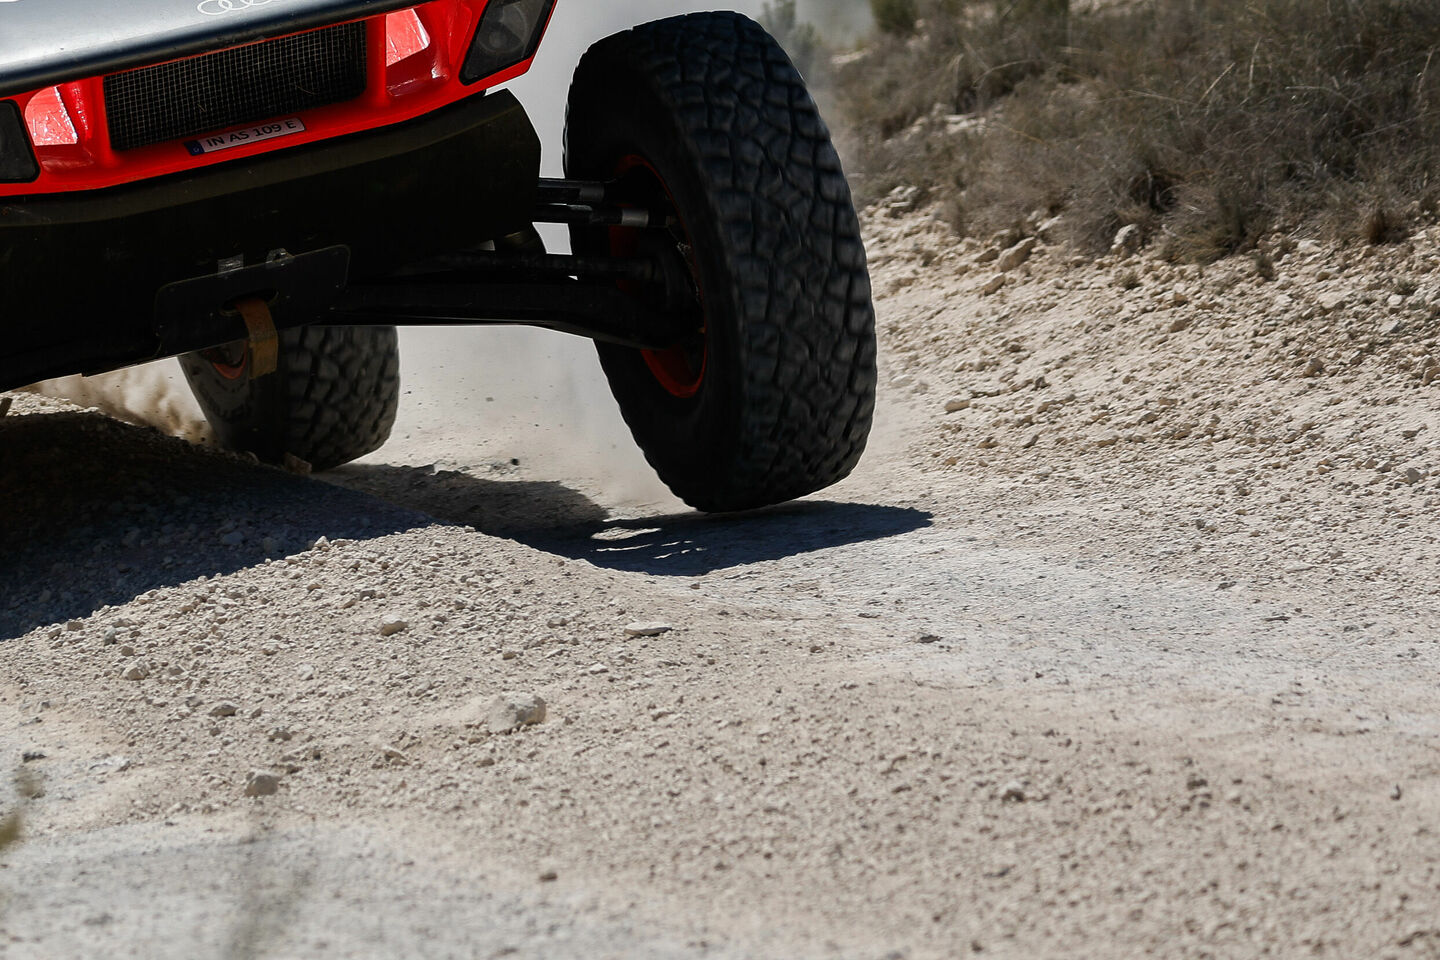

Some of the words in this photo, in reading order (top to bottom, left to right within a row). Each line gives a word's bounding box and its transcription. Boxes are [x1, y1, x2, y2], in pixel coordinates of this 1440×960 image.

[206, 136, 225, 147] IN
[229, 130, 250, 142] AS
[253, 124, 281, 137] 109
[285, 120, 297, 130] E
